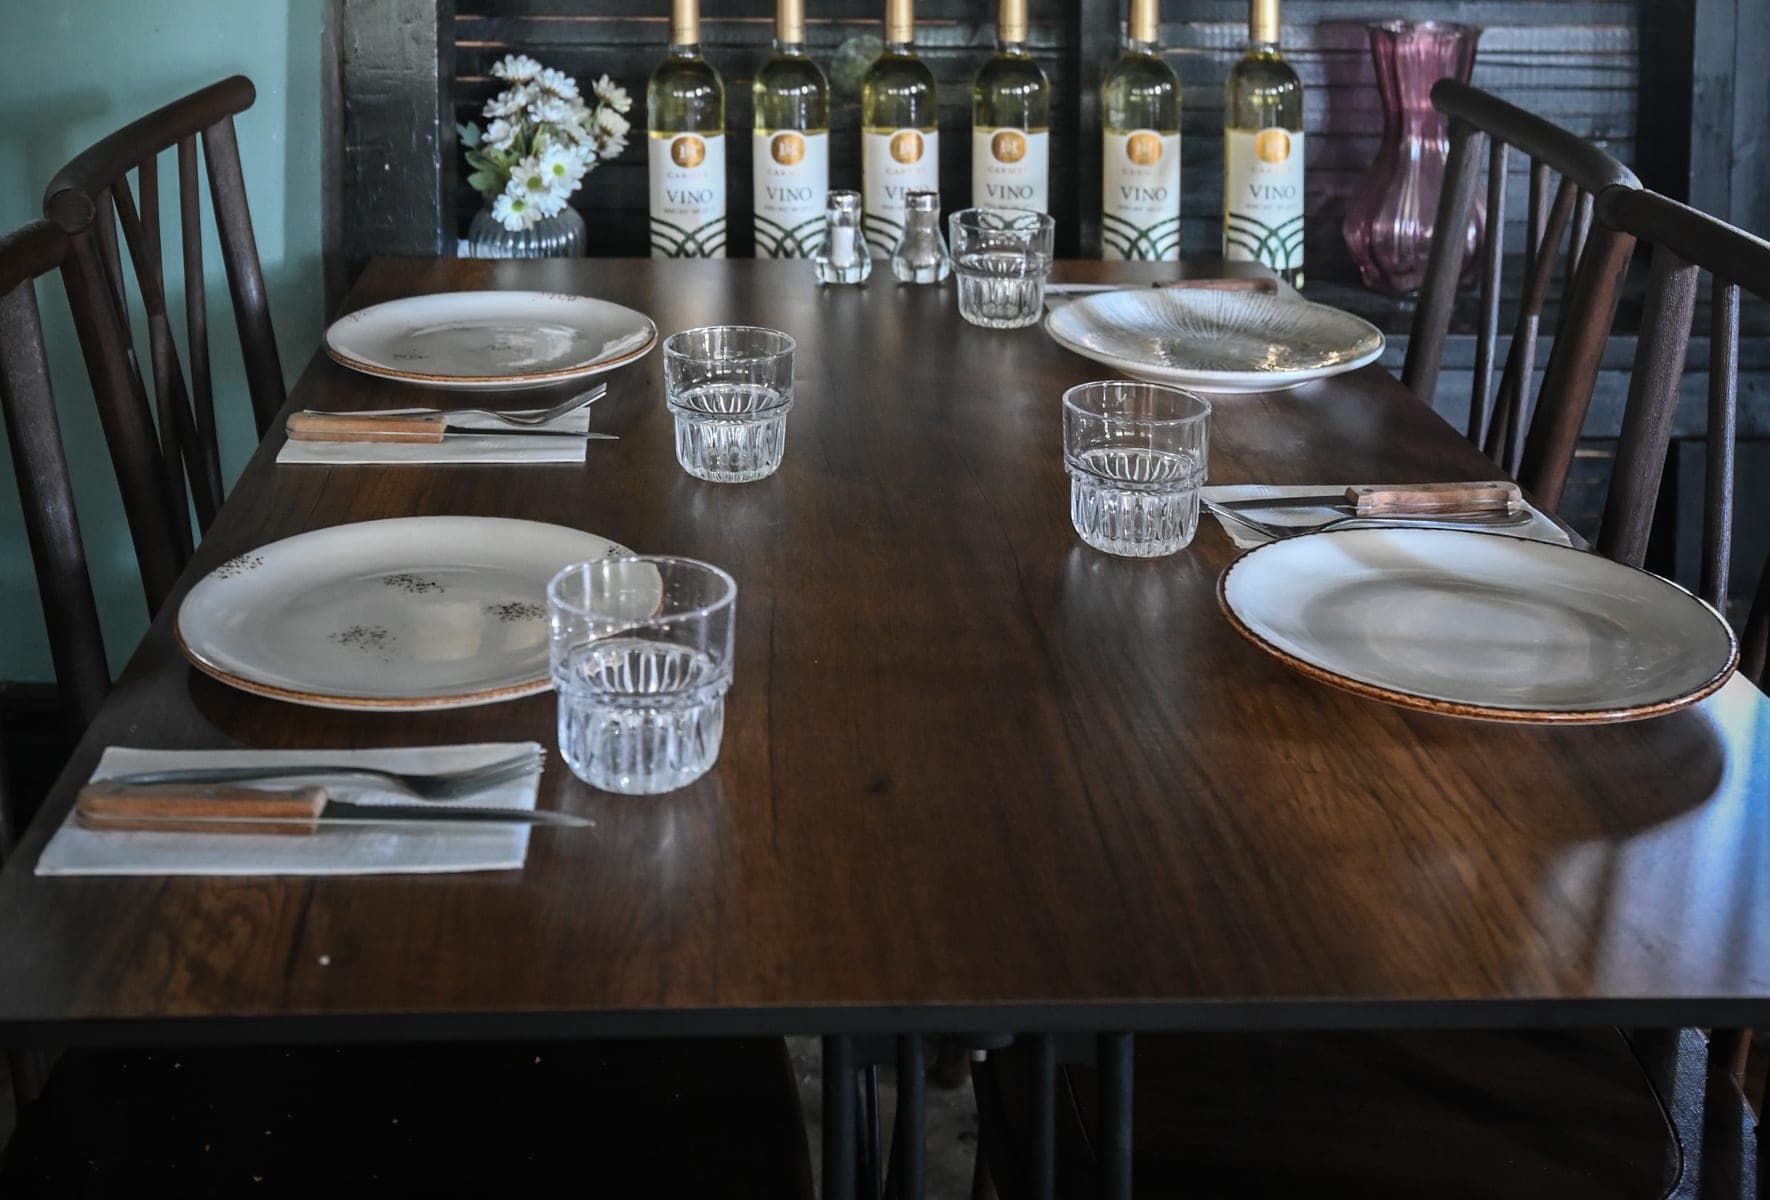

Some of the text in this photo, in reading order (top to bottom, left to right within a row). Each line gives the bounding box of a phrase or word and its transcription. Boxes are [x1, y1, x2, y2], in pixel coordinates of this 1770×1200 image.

[665, 188, 713, 205] VINO
[765, 185, 813, 202] VINO
[985, 183, 1034, 200] VINO
[1120, 184, 1168, 201] VINO
[1248, 184, 1297, 200] VINO
